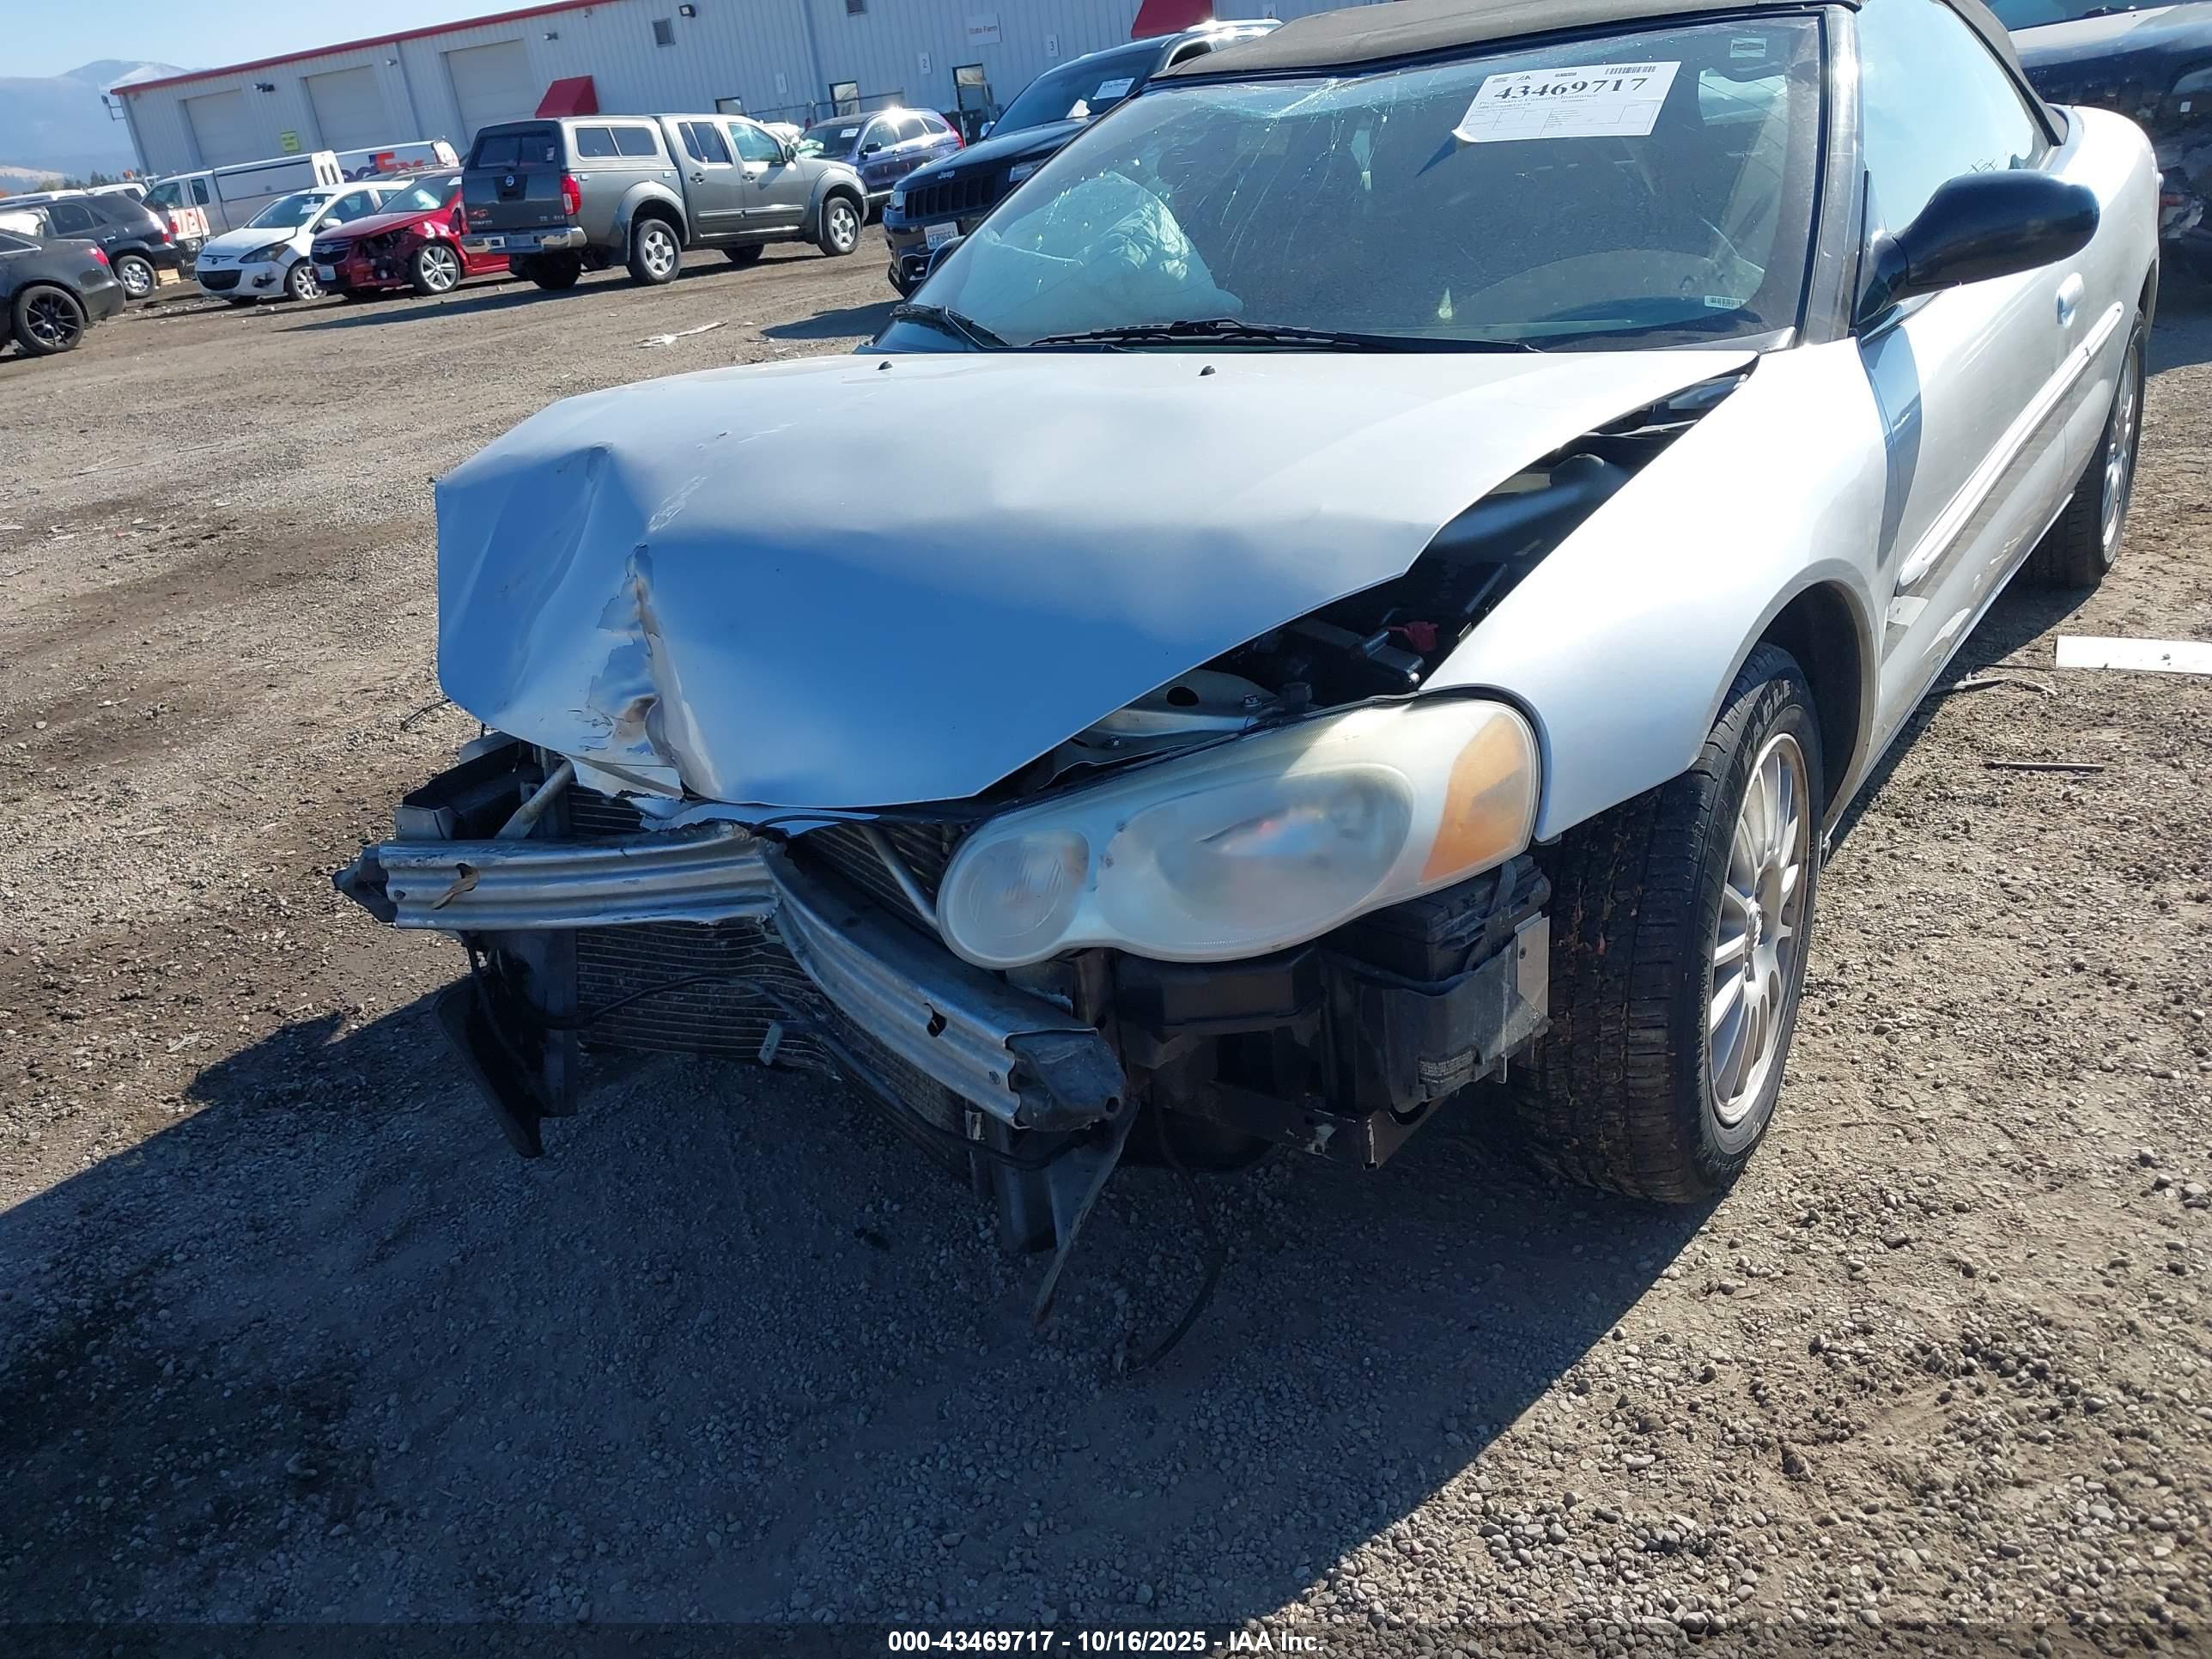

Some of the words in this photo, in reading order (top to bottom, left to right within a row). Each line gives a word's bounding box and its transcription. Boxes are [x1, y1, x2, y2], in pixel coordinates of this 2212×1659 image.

[1049, 40, 1054, 52] 3
[922, 58, 928, 69] 2
[1493, 77, 1649, 100] 43469717
[938, 170, 955, 179] Jeep
[1743, 679, 1791, 776] EAGLE
